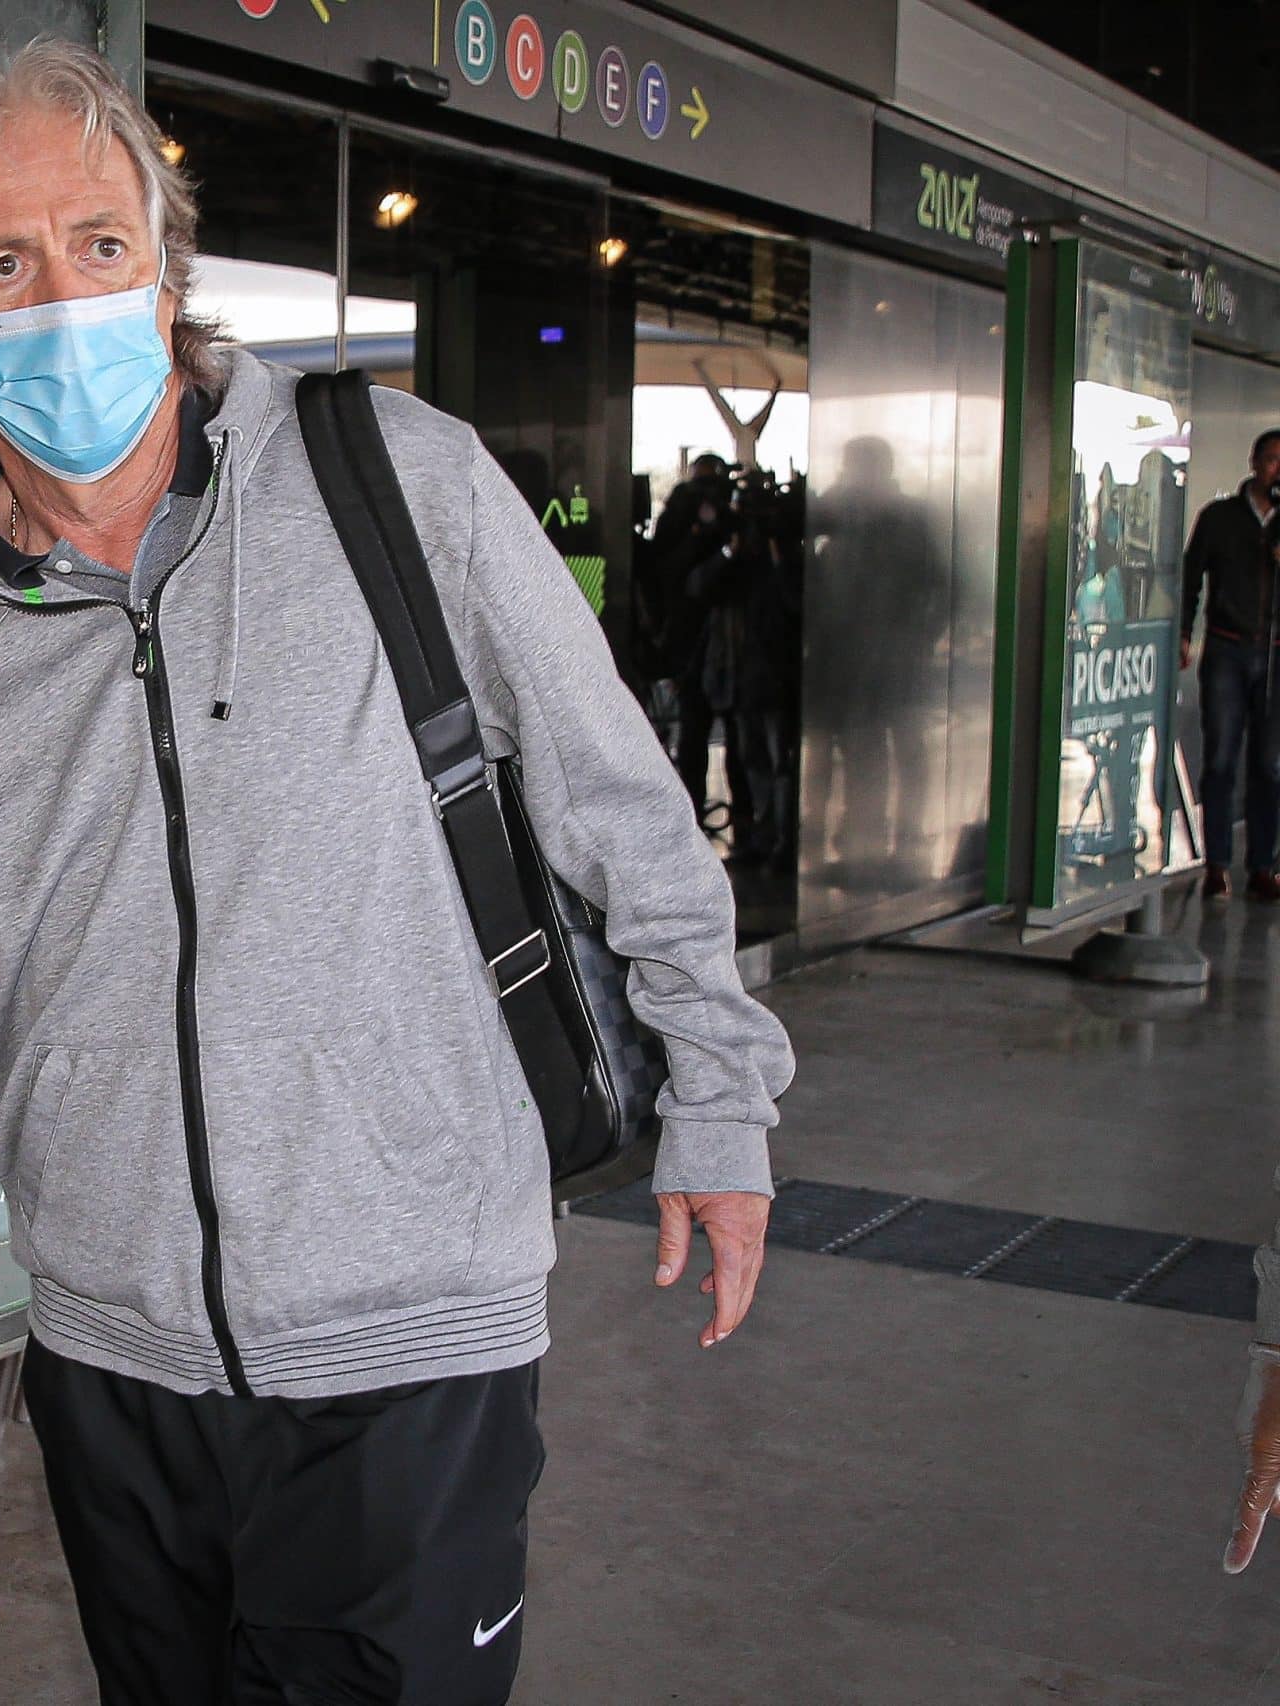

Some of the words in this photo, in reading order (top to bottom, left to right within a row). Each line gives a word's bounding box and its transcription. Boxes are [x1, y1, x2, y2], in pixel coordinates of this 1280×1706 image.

[468, 15, 486, 66] B
[517, 33, 535, 81] C
[564, 48, 580, 94] D
[606, 63, 621, 111] E
[647, 77, 662, 122] F
[1072, 643, 1157, 706] PICASSO
